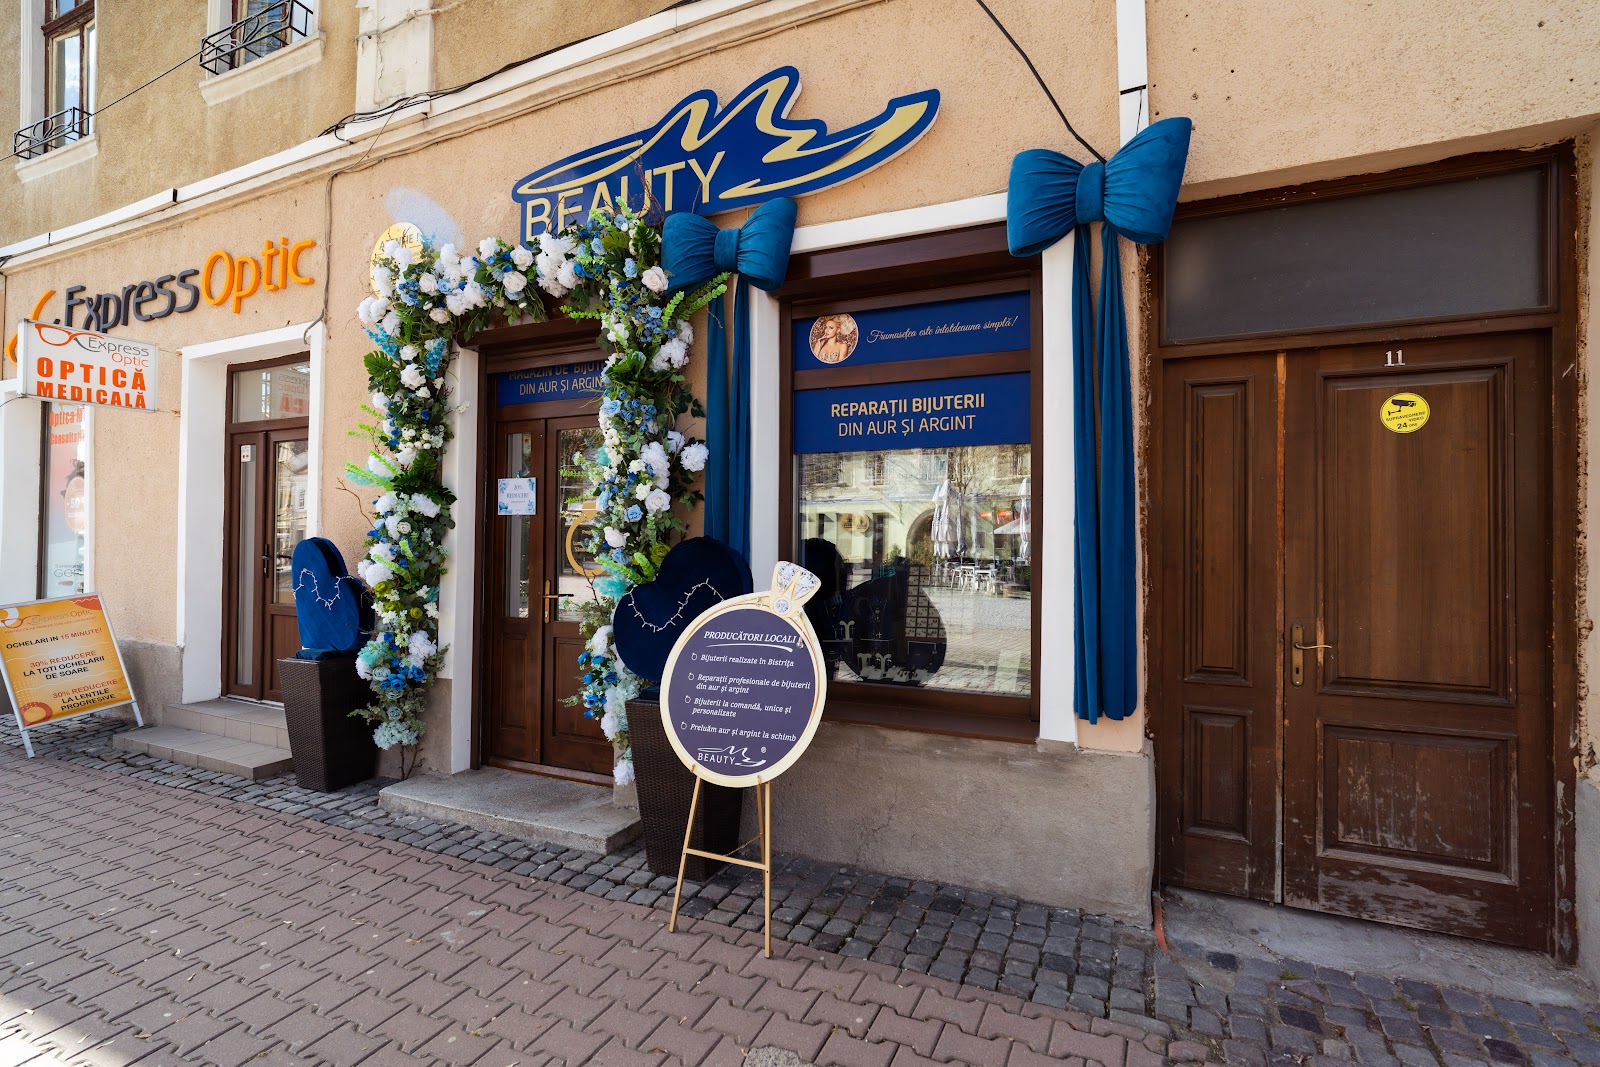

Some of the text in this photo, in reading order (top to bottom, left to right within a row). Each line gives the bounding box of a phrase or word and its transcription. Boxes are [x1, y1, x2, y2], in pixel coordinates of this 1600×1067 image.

[525, 151, 725, 242] BEAUTY
[201, 236, 317, 315] Optic
[866, 315, 1019, 344] Frumusețea este întotdeauna simplă!
[88, 336, 149, 357] Express
[111, 352, 149, 367] Optic
[1384, 349, 1405, 367] 11
[37, 357, 146, 391] OPTICĂ
[555, 364, 569, 376] DE
[36, 381, 146, 409] MEDICALĂ
[519, 376, 603, 396] DIN AUR ȘI ARGIN
[831, 393, 985, 418] REPARAȚII BIJUTERII
[838, 415, 977, 437] DIN AUR ȘI ARGINT
[1397, 422, 1408, 430] 24
[70, 609, 93, 618] Optic
[6, 637, 49, 649] OCHELARI
[70, 628, 103, 639] MINUTE!
[704, 631, 764, 642] PRODUCĂTORI
[764, 634, 797, 644] LOCALI
[29, 650, 97, 668] 30% REDUCERE
[37, 666, 57, 675] TOTI
[58, 655, 105, 670] OCHELARII
[700, 654, 728, 662] Bijuterii
[728, 656, 758, 664] realizate
[767, 659, 795, 668] Bistrița
[59, 666, 89, 678] SOARE
[52, 678, 118, 699] 30% REDUCERE
[697, 674, 728, 684] Reparații
[728, 676, 770, 686] profesionale
[781, 681, 811, 690] bijuterii
[728, 686, 750, 694] argint
[60, 693, 116, 711] PROGRESIVE
[74, 688, 110, 701] LENTILE
[692, 707, 737, 718] personalizate
[694, 698, 722, 706] Bijuterii
[722, 700, 729, 708] la
[764, 704, 783, 713] unice
[690, 723, 717, 733] Preluăm
[739, 730, 761, 738] argint
[762, 731, 769, 739] la
[770, 733, 797, 742] schimb
[697, 752, 736, 765] BEAUTY
